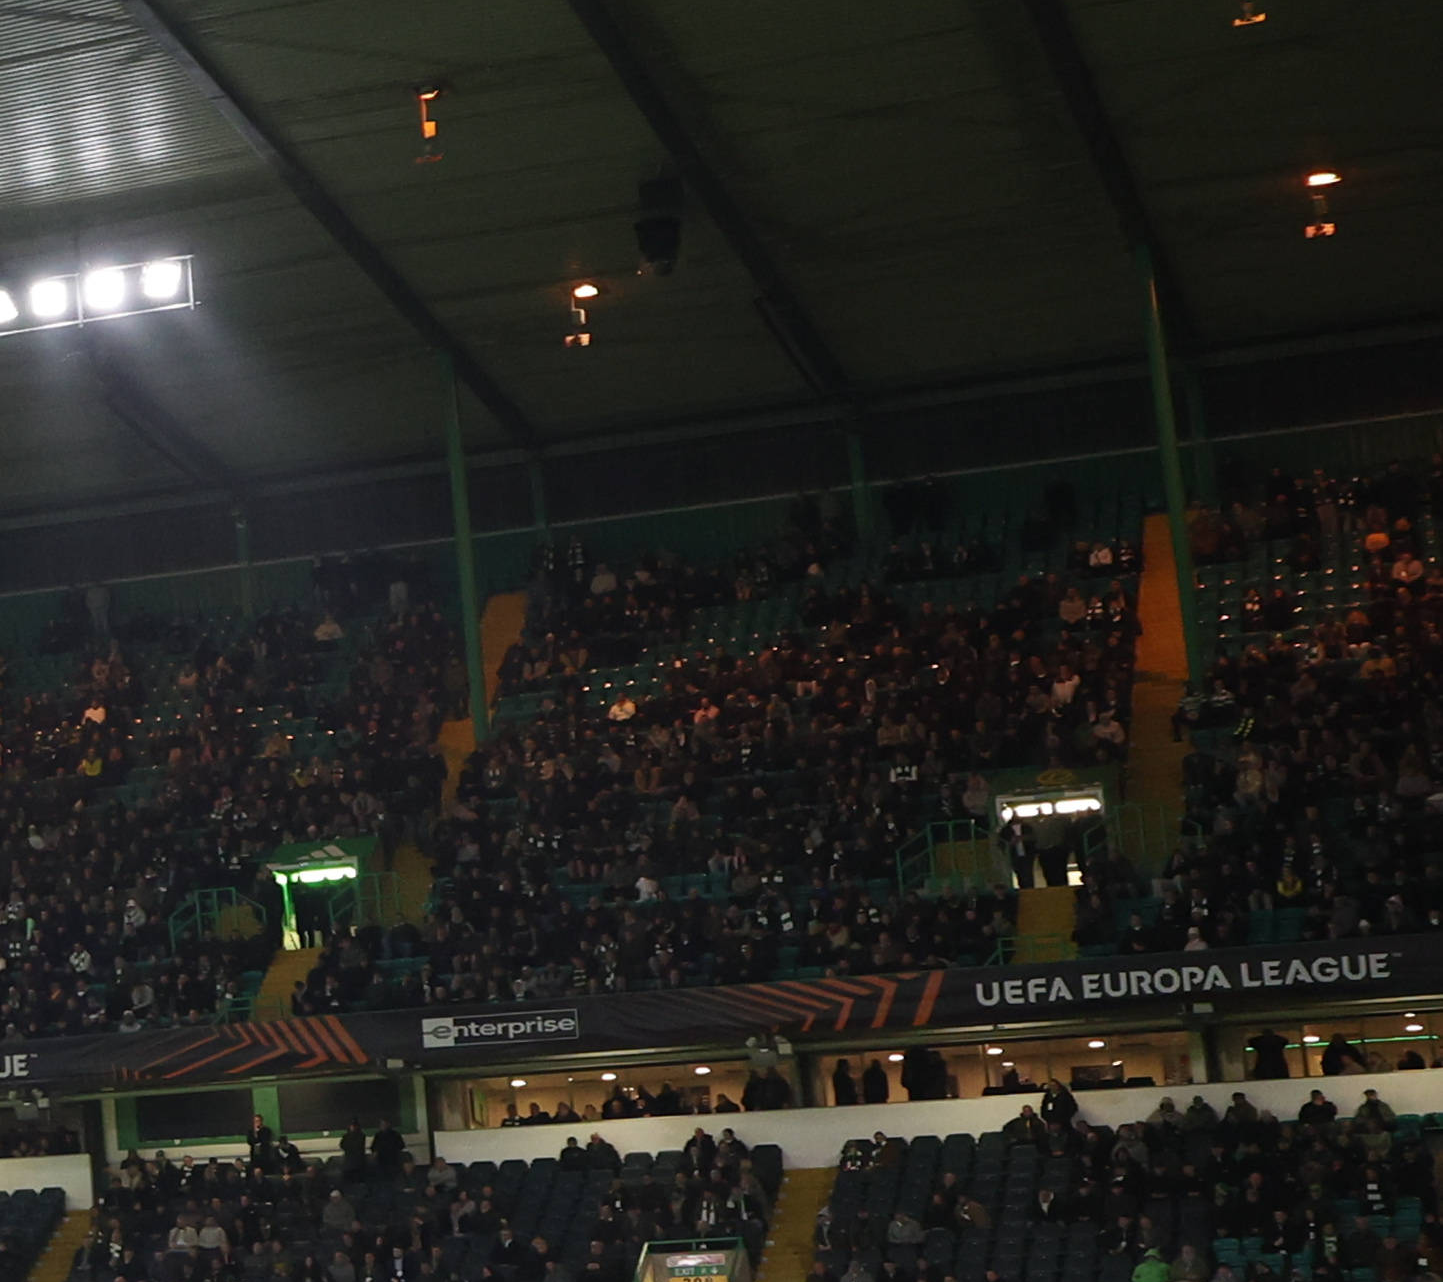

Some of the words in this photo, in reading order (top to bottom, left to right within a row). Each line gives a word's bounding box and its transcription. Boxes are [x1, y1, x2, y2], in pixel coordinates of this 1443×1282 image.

[975, 976, 1072, 1007] UEFA
[1081, 964, 1232, 999] EUROPA
[431, 1016, 576, 1039] enterprise
